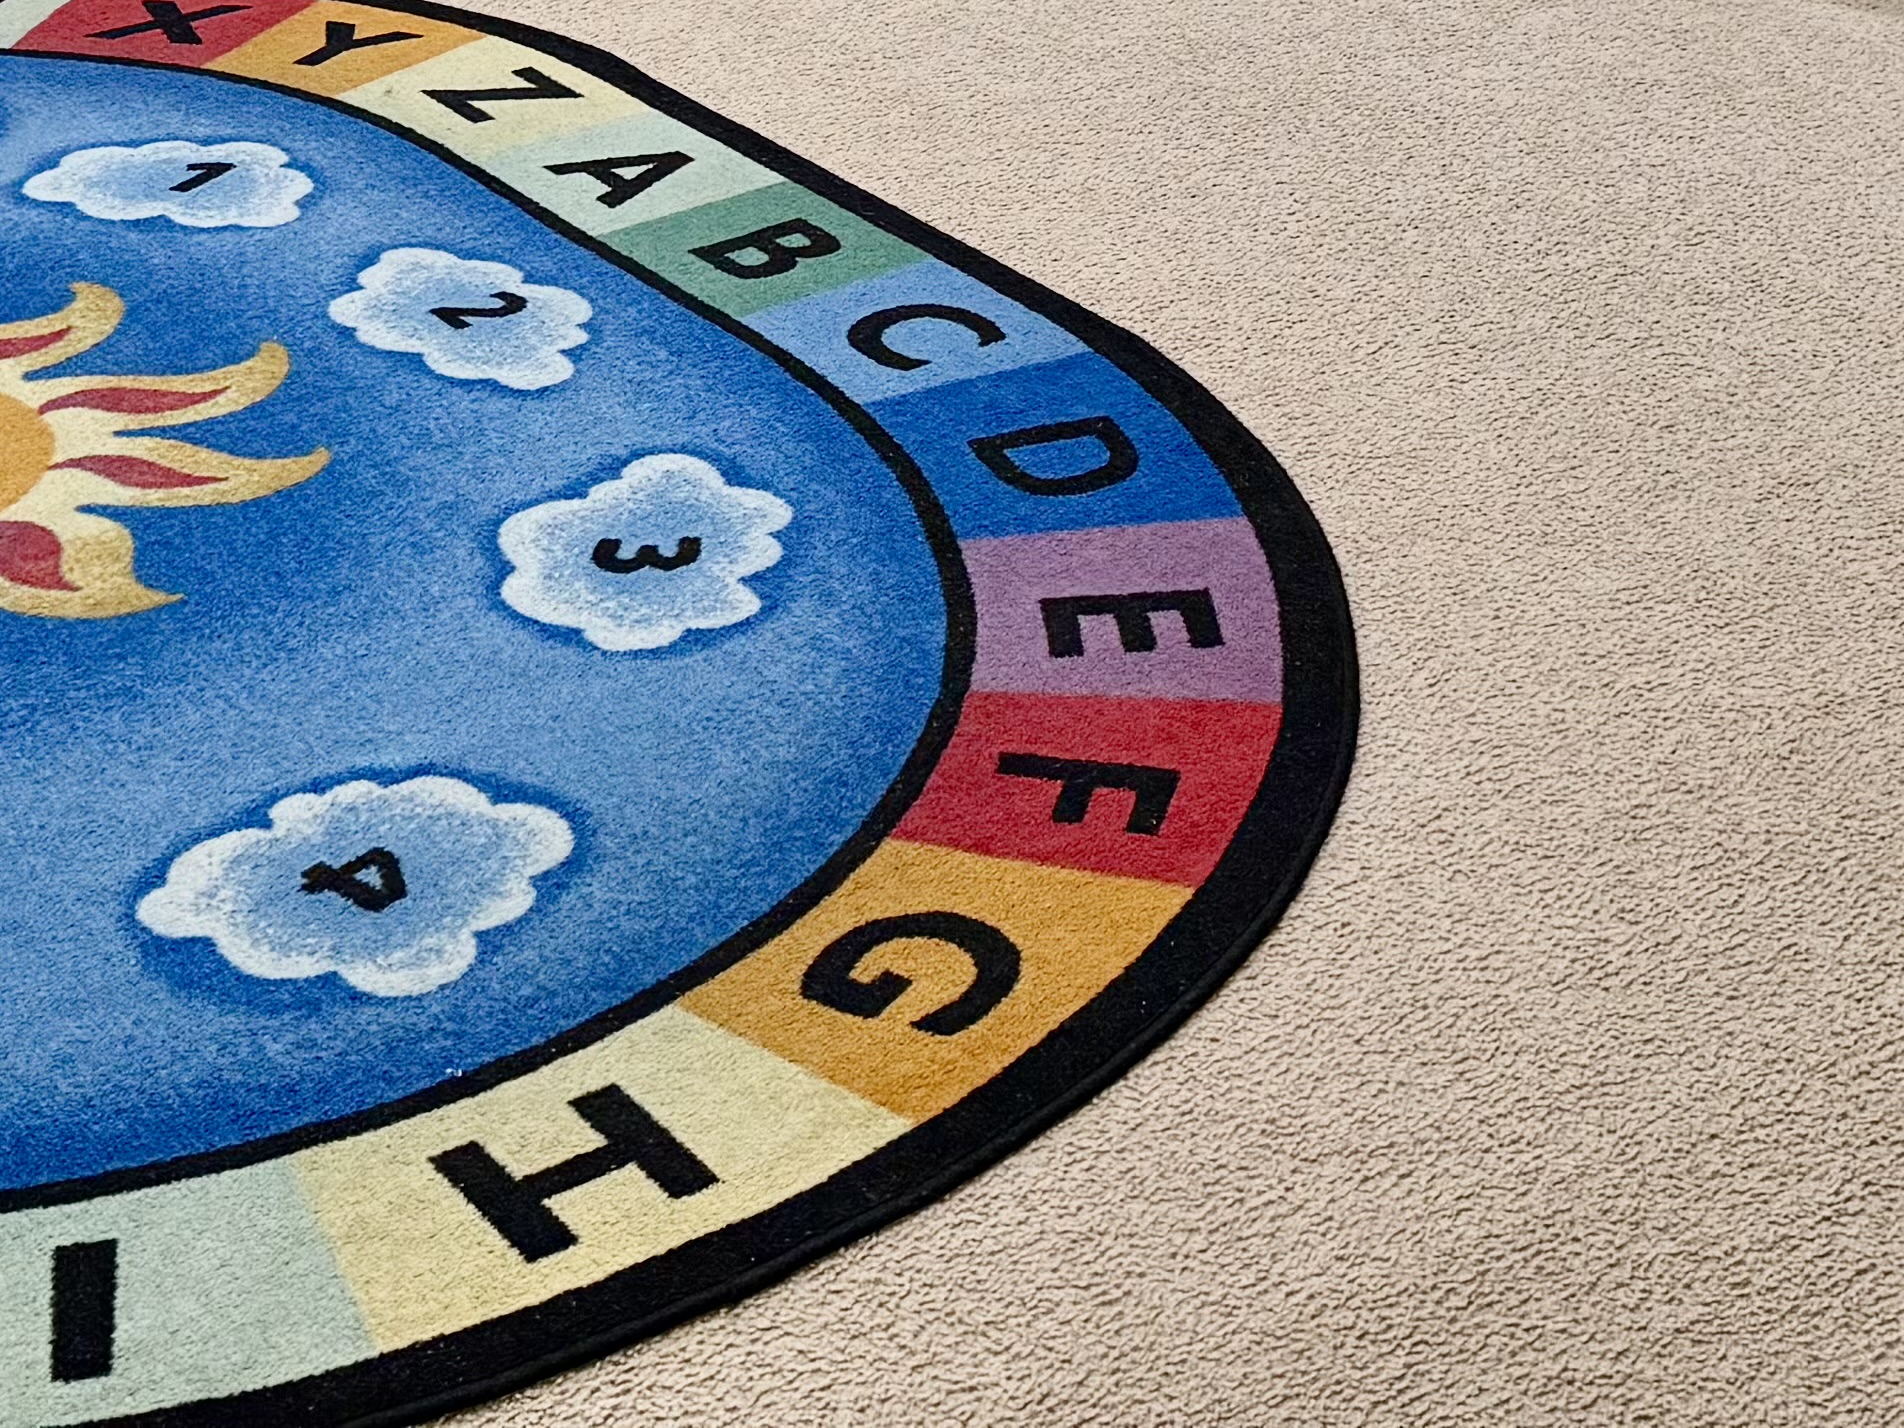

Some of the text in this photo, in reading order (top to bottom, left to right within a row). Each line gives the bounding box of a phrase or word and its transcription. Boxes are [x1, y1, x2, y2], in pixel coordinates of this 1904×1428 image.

[90, 1, 245, 44] X
[296, 22, 420, 65] Y
[423, 67, 582, 123] Z
[171, 163, 233, 191] 1
[545, 152, 693, 208] A
[688, 218, 841, 279] B
[431, 292, 526, 328] 2
[848, 305, 1005, 370] C
[969, 417, 1138, 496] D
[592, 537, 700, 573] 3
[1039, 588, 1225, 658] E
[997, 753, 1180, 835] F
[302, 848, 406, 912] 4
[801, 912, 1021, 1035] G
[430, 1080, 720, 1268] H
[50, 1239, 118, 1383] I
